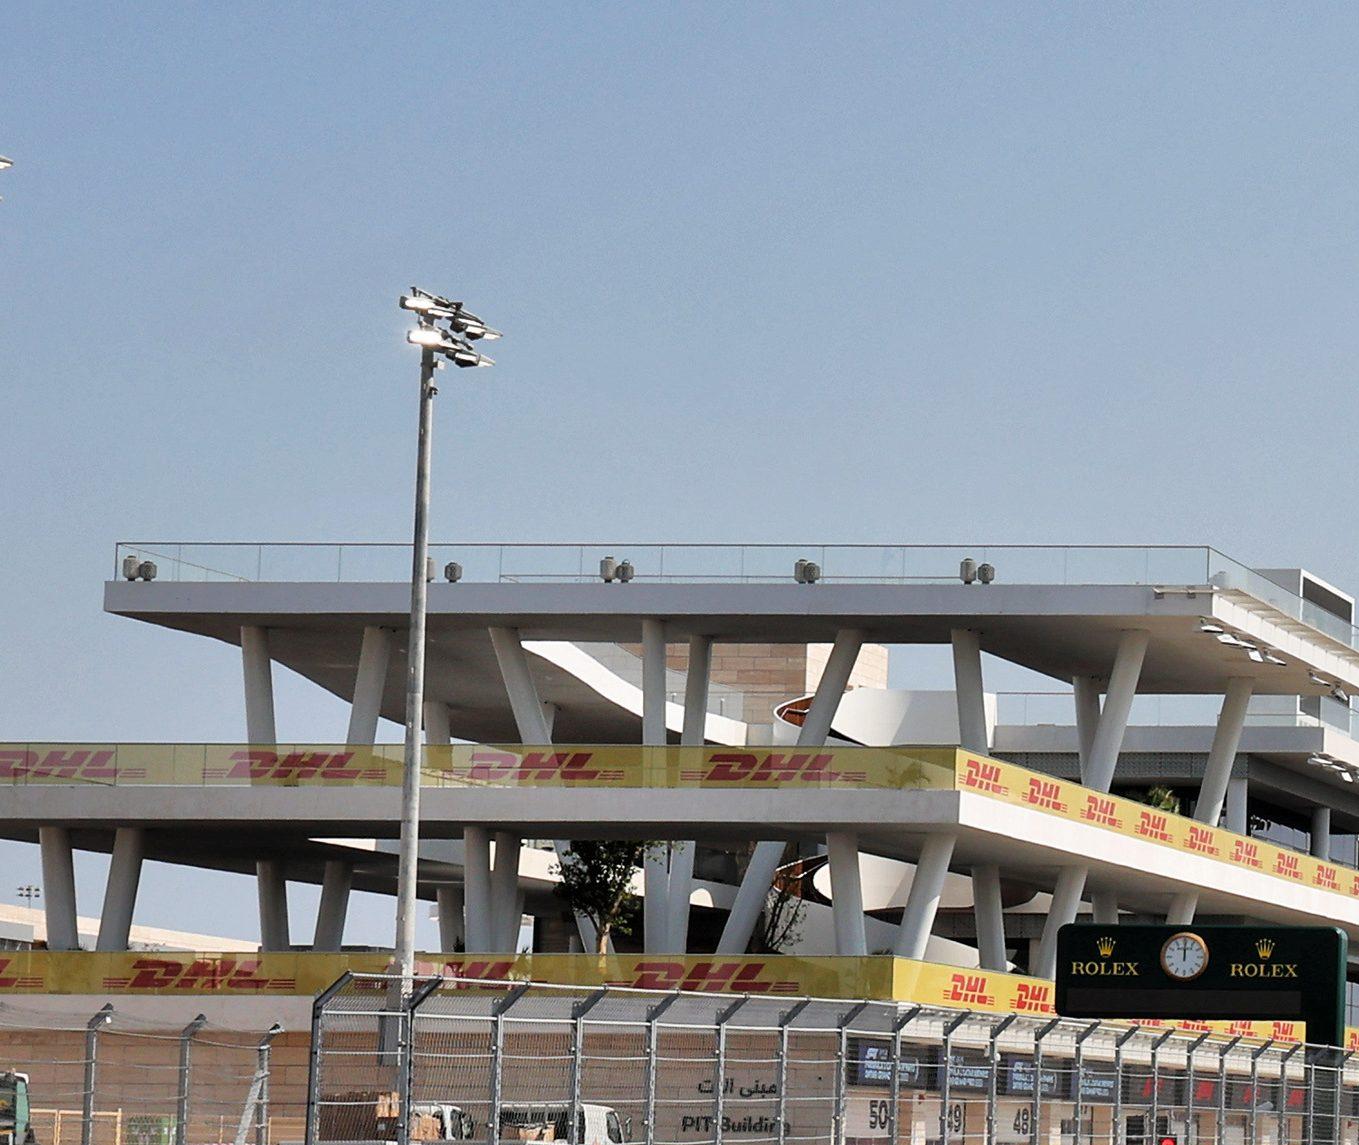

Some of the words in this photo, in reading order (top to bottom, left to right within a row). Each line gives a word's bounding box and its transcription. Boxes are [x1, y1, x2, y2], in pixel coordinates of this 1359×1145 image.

[0, 750, 134, 779] DHL
[217, 750, 370, 780] DHL
[462, 751, 606, 782] DHL
[697, 752, 848, 782] DHL
[964, 758, 1005, 795] DHL
[1026, 776, 1063, 811] DHL
[1084, 794, 1119, 828] DHL
[1138, 810, 1170, 842] DHL
[1187, 825, 1217, 856] DHL
[1234, 839, 1259, 868] DHL
[1276, 851, 1300, 880] DHL
[1316, 864, 1338, 890] DHL
[120, 959, 276, 989] DHL
[623, 962, 775, 993] DHL
[1071, 961, 1139, 976] ROLEX
[1230, 963, 1299, 978] ROLEX
[949, 973, 990, 1005] DHL
[1015, 983, 1052, 1013] DHL
[1271, 1020, 1297, 1042] DHL
[681, 1116, 714, 1133] PIT
[869, 1099, 888, 1130] 50
[1013, 1107, 1029, 1135] 48
